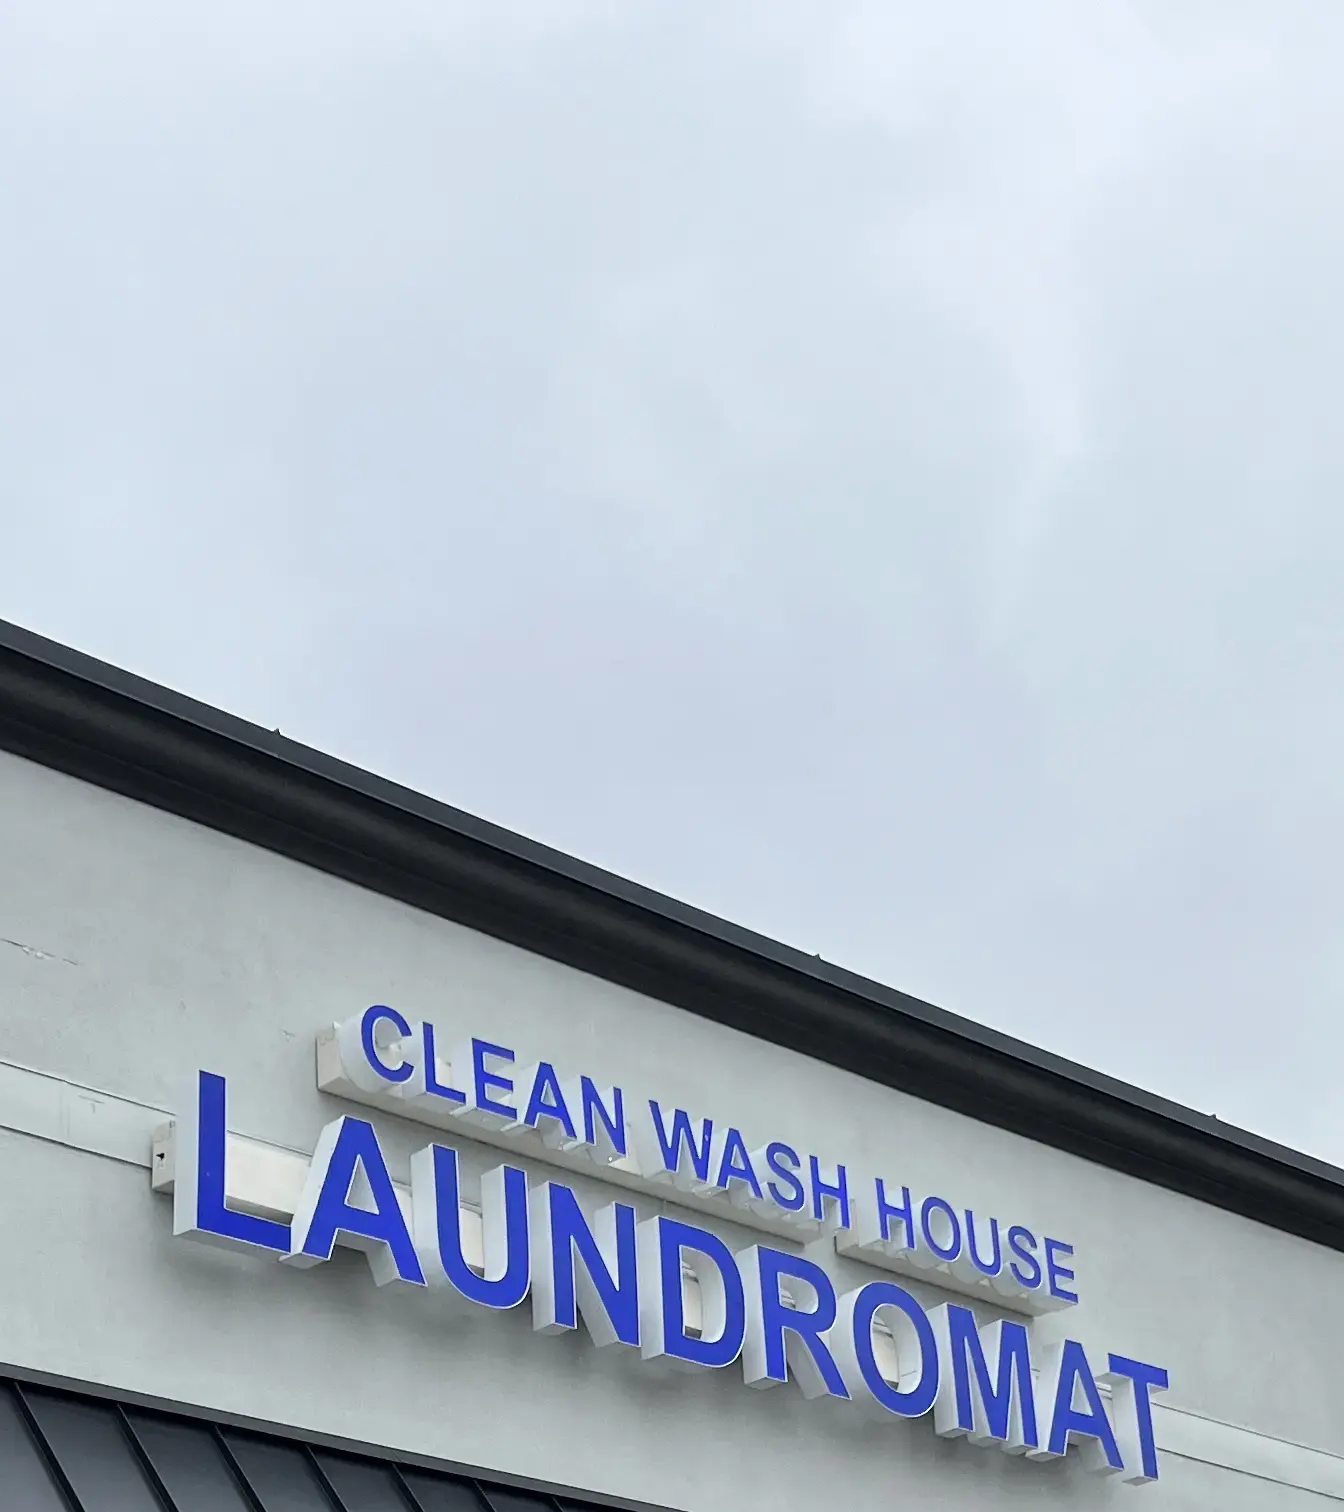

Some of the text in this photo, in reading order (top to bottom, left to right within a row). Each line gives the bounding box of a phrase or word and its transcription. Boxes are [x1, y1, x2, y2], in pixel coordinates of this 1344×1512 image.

[192, 1070, 1169, 1484] LAUNDROMAT
[361, 1004, 1080, 1304] CLEAN WASH HOUSE
